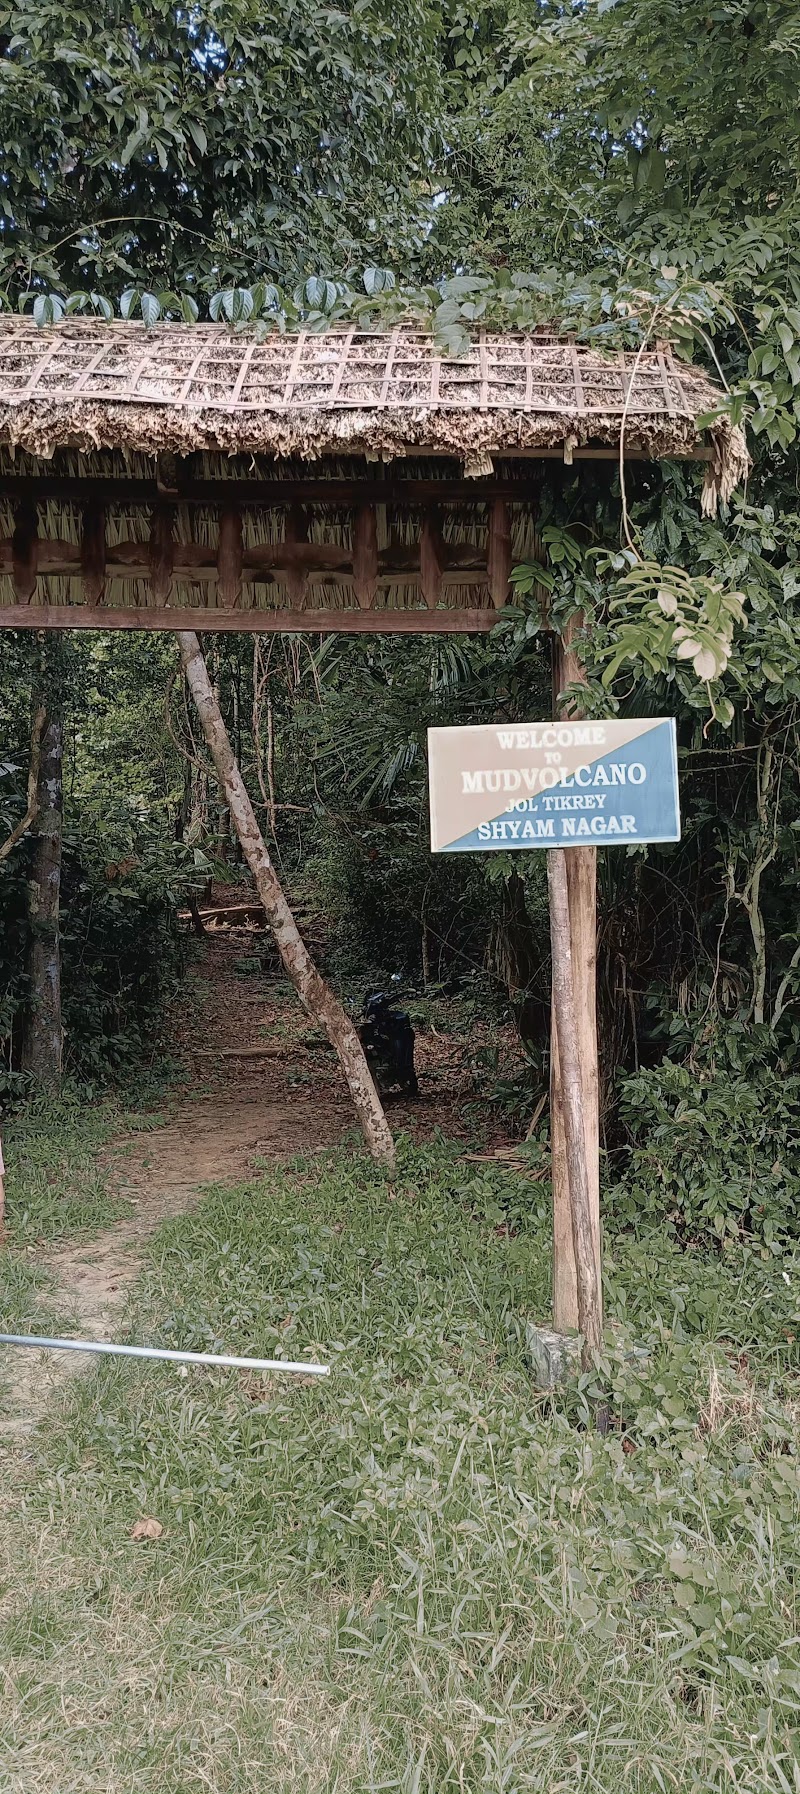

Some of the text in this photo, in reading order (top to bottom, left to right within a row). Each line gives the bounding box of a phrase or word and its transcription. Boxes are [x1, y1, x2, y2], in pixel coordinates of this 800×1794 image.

[497, 726, 606, 750] WELCOME
[544, 752, 562, 765] TO
[461, 762, 647, 794] MUDVOLCANO
[505, 794, 607, 814] JOL TIKREY
[477, 815, 638, 840] SHYAM NAGAR
